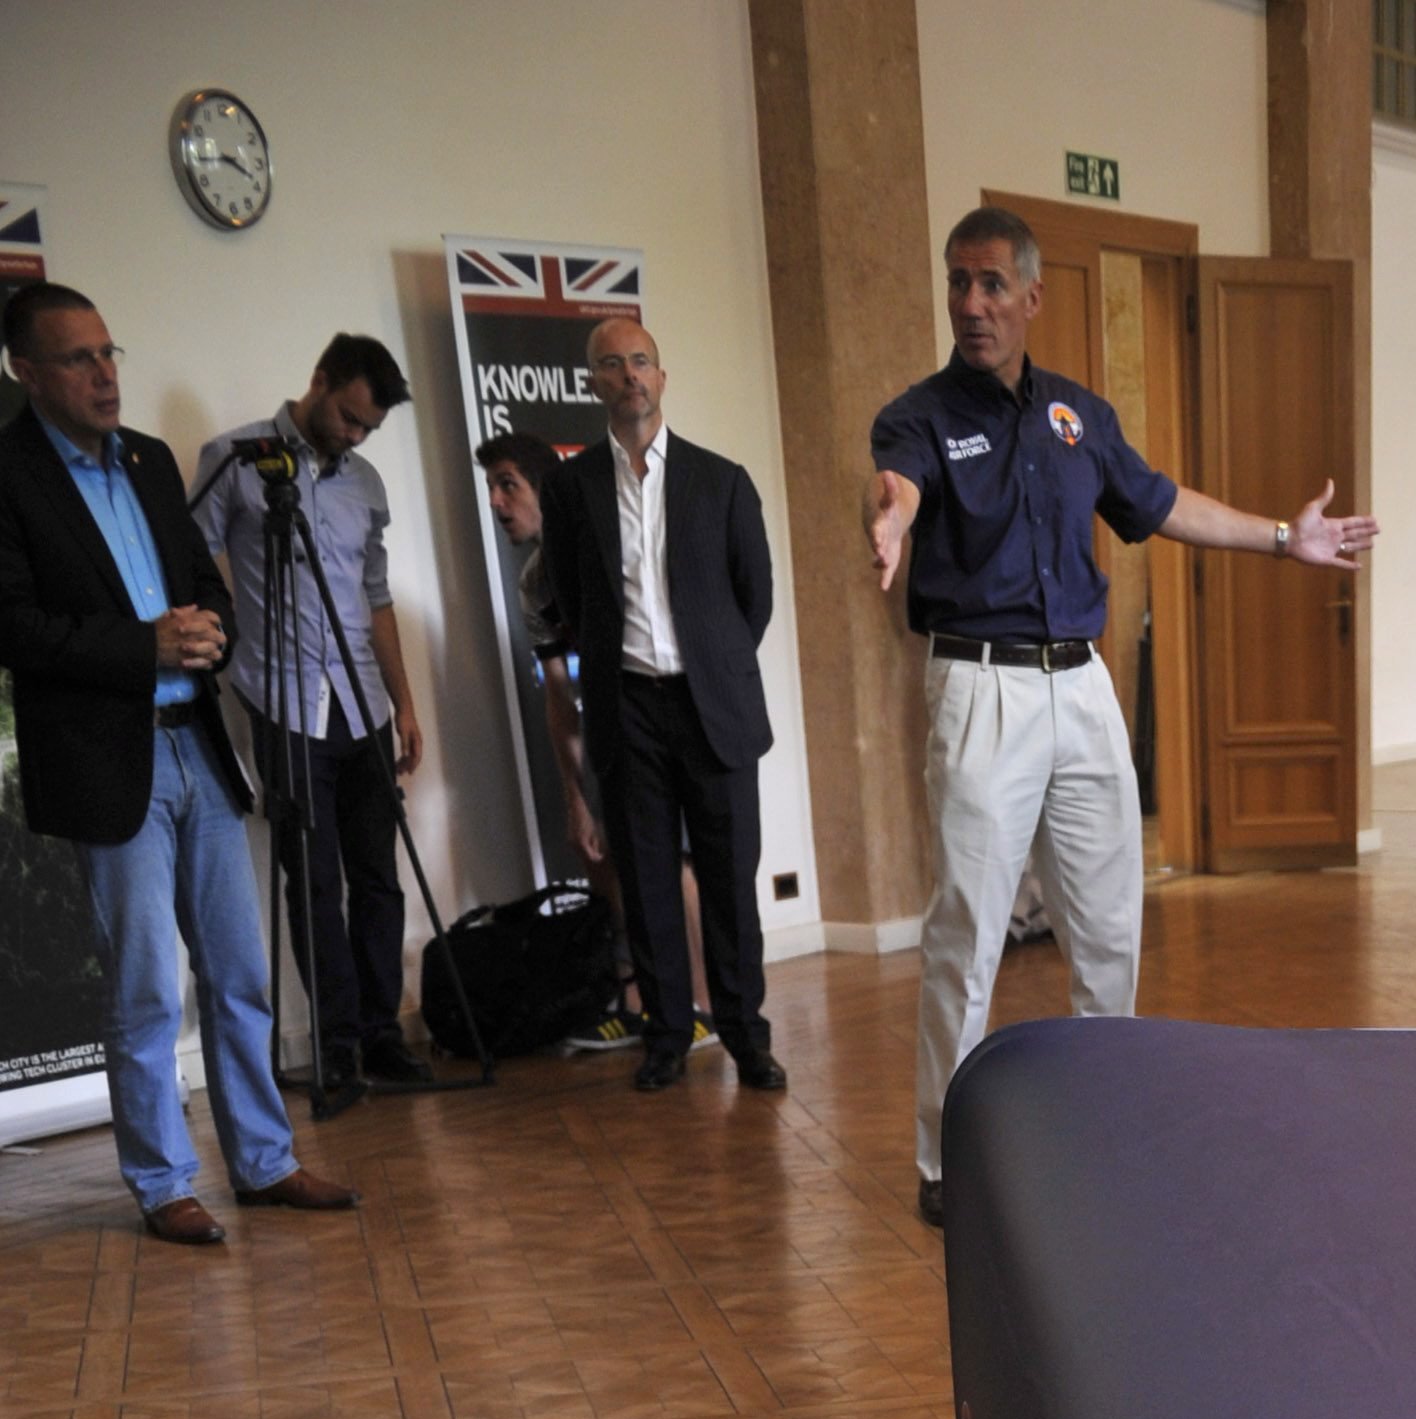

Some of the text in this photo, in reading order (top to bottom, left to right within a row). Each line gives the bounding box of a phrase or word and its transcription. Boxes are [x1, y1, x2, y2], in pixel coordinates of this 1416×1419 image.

[248, 132, 257, 145] 2
[255, 158, 264, 171] 3
[253, 180, 261, 192] 4
[213, 193, 221, 206] 7
[477, 364, 602, 403] KNOWLE
[483, 404, 513, 440] IS
[30, 1054, 40, 1065] IS
[40, 1051, 58, 1063] THE
[58, 1043, 95, 1060] LARGEST
[23, 1065, 45, 1079] TECH
[46, 1057, 83, 1074] CLUSTER
